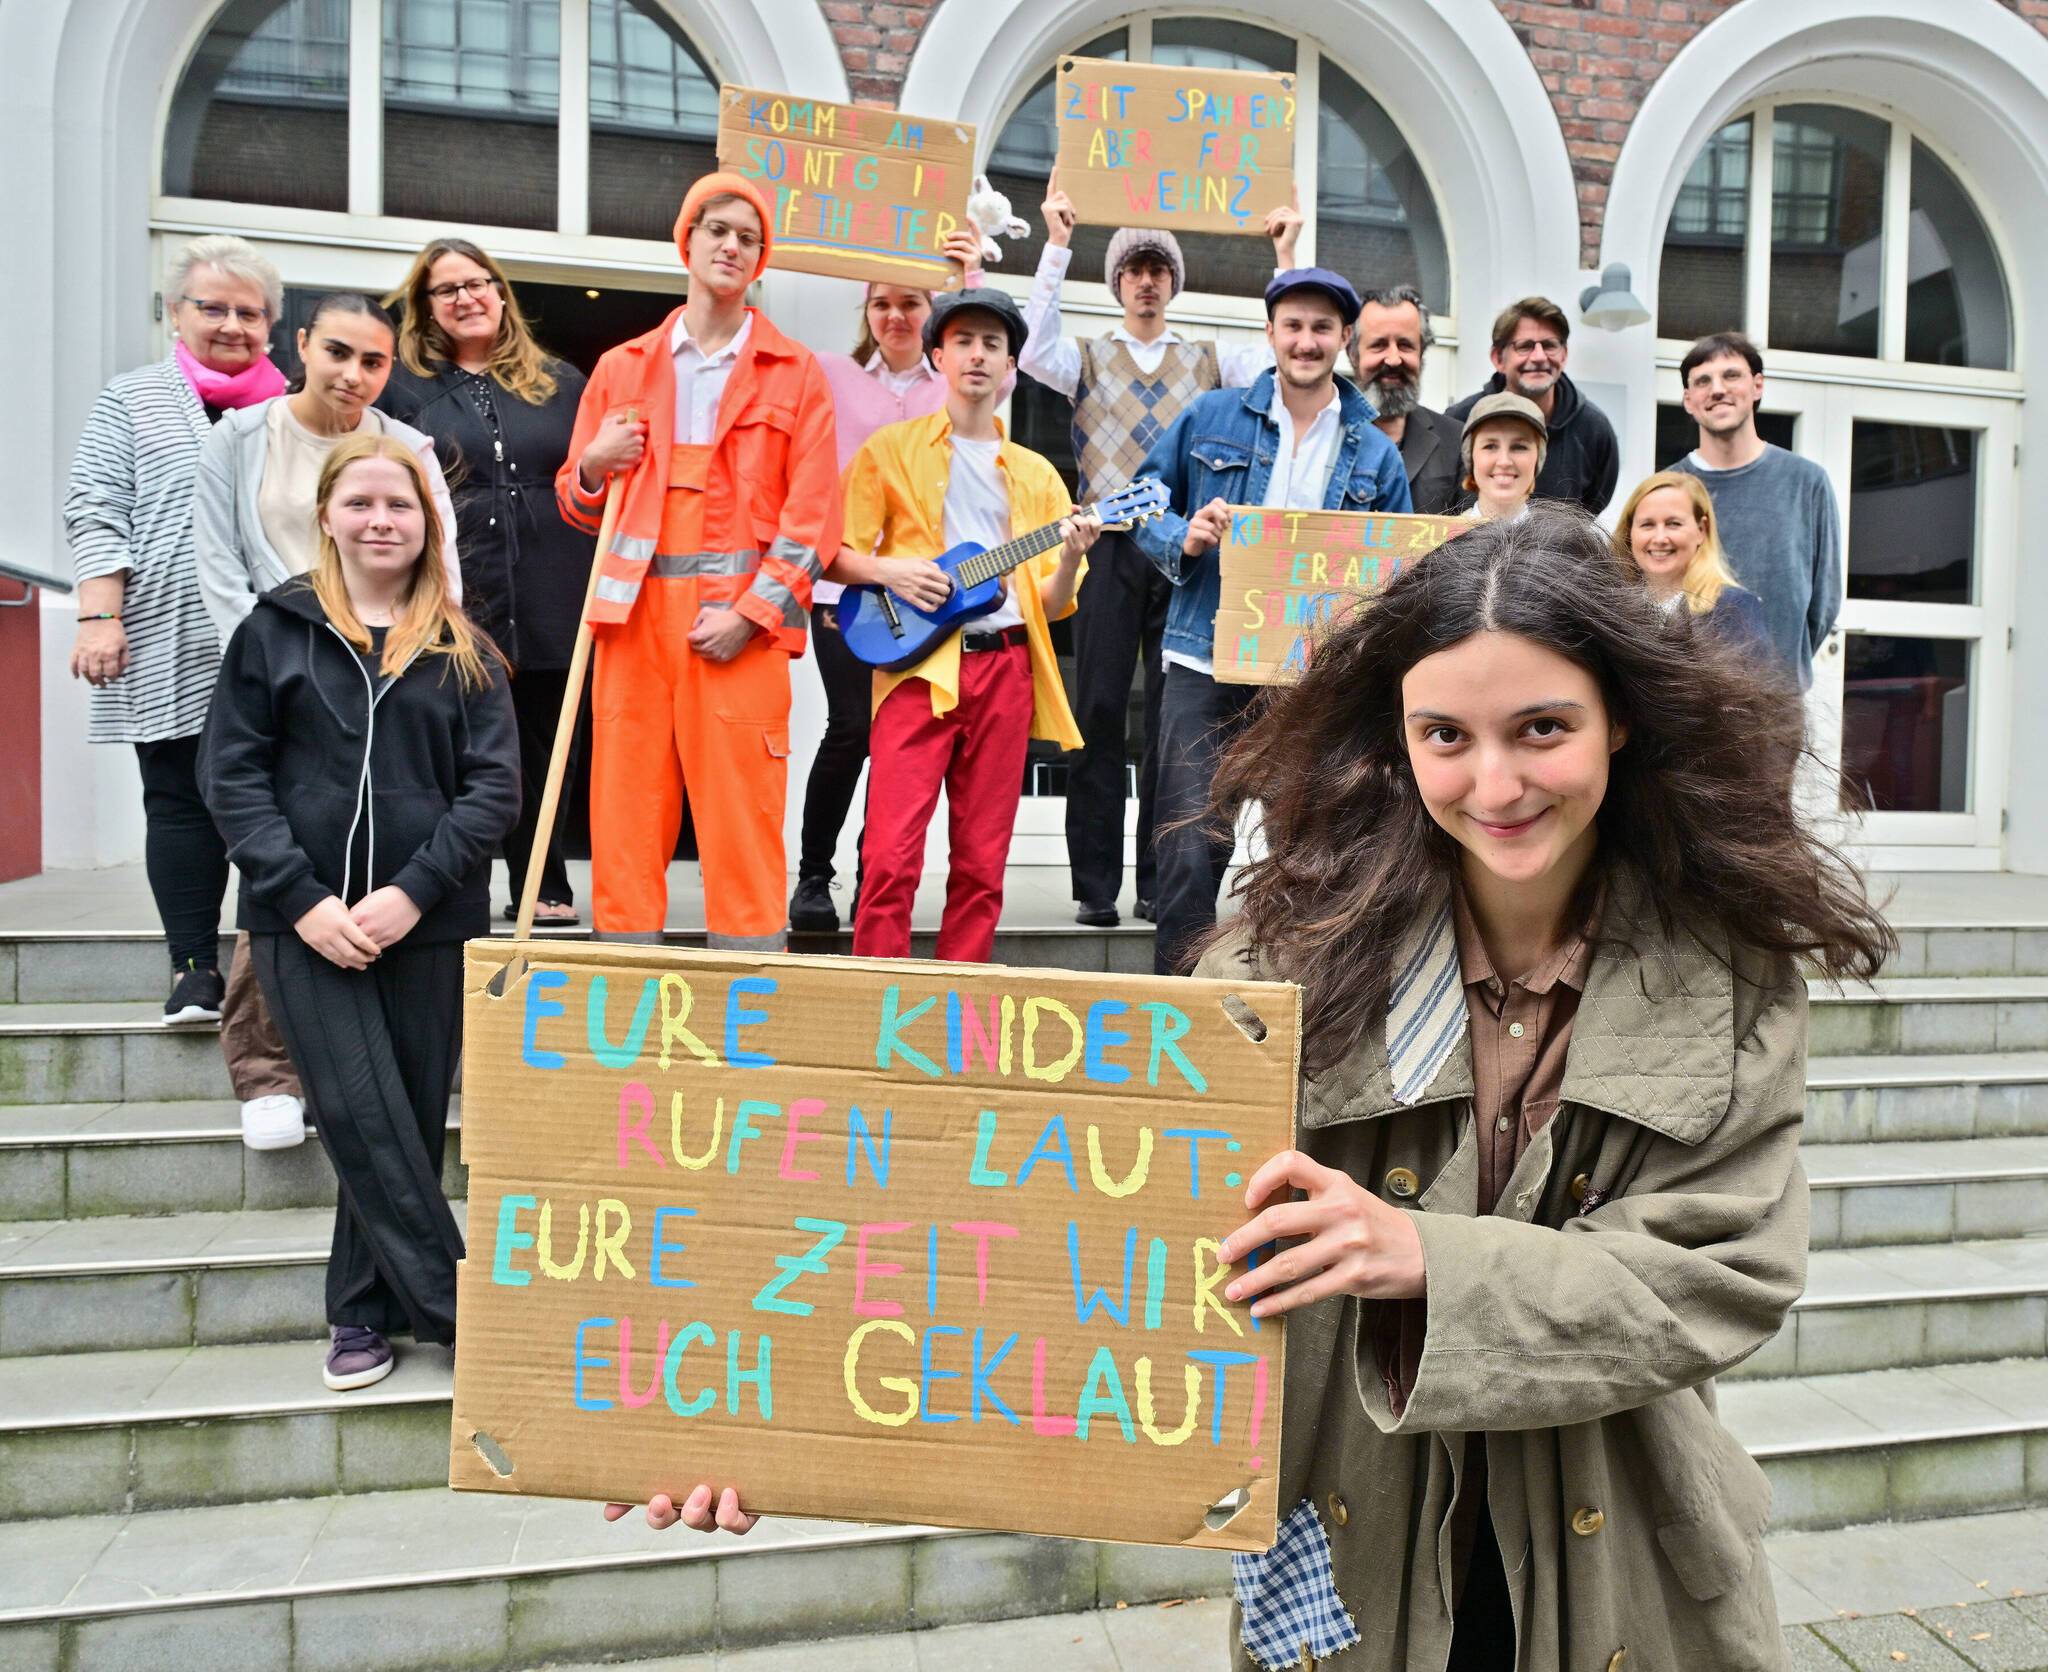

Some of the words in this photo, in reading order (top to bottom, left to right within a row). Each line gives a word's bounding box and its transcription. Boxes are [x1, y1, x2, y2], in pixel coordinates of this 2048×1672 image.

[749, 98, 863, 141] KOMMT
[885, 121, 923, 150] AM
[1065, 83, 1136, 120] ZEIT
[740, 139, 878, 191] SONNTAG
[914, 164, 945, 200] IM
[1088, 128, 1154, 169] ABER
[1123, 171, 1253, 228] WEHN?
[1231, 512, 1308, 548] KOMT
[1324, 517, 1397, 549] ALLE
[522, 970, 779, 1072] EURE
[617, 1081, 892, 1189] RUFEN
[969, 1111, 1242, 1199] LAUT:
[492, 1195, 698, 1288] EURE
[752, 1216, 1020, 1317] ZEIT
[574, 1316, 774, 1421] EUCH
[842, 1319, 1268, 1469] GEKLAUT!
